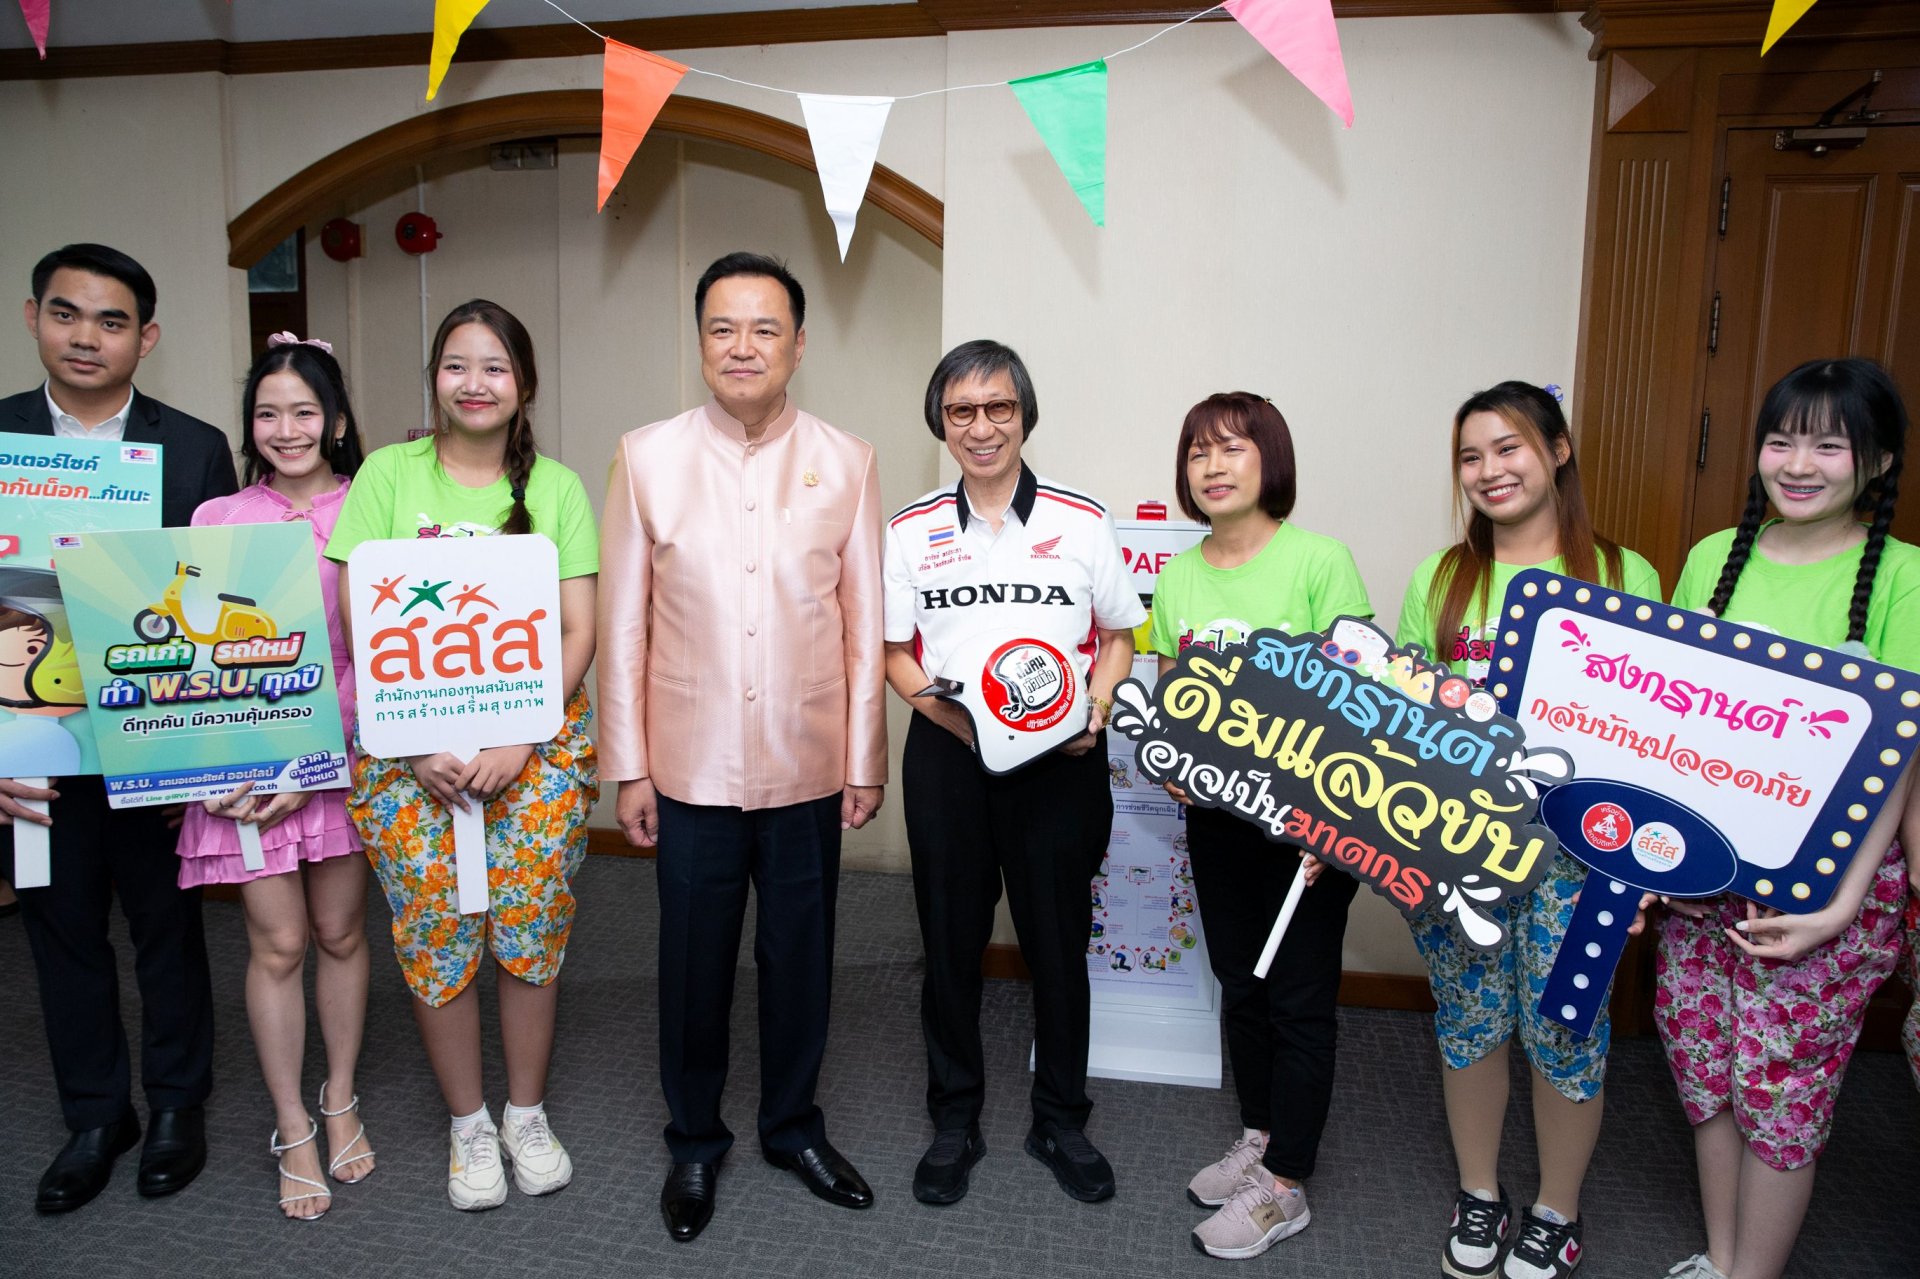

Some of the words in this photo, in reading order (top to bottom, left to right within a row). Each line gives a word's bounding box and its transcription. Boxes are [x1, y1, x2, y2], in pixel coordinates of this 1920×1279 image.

[1132, 552, 1178, 574] AE
[920, 583, 1075, 610] HONDA
[108, 640, 194, 666] รถเก่า
[215, 635, 301, 661] รถใหม่
[369, 608, 547, 684] สสส
[100, 679, 136, 705] ทำ
[148, 669, 256, 701] พ.ร.บ.
[264, 664, 323, 699] ทุกปี
[375, 680, 544, 704] สำนักงานกองทุนสนับสนุน
[1582, 653, 1803, 740] สงกรานต์
[123, 714, 184, 734] ดีทุกคัน
[192, 706, 312, 727] มีความคุ้มครอง
[376, 697, 545, 722] การสร้างเสริมสุขภาพ
[1250, 636, 1514, 777] สงกรานต์
[299, 751, 329, 766] ราคา
[1530, 698, 1812, 808] กลับบ้านปลอดภัย
[109, 778, 153, 791] พ.ร.บ.
[227, 766, 274, 780] ออนไลน์
[301, 770, 337, 786] กำหนด
[1162, 656, 1545, 883] ดื่มแล้วขับ
[1637, 835, 1680, 860] สสส
